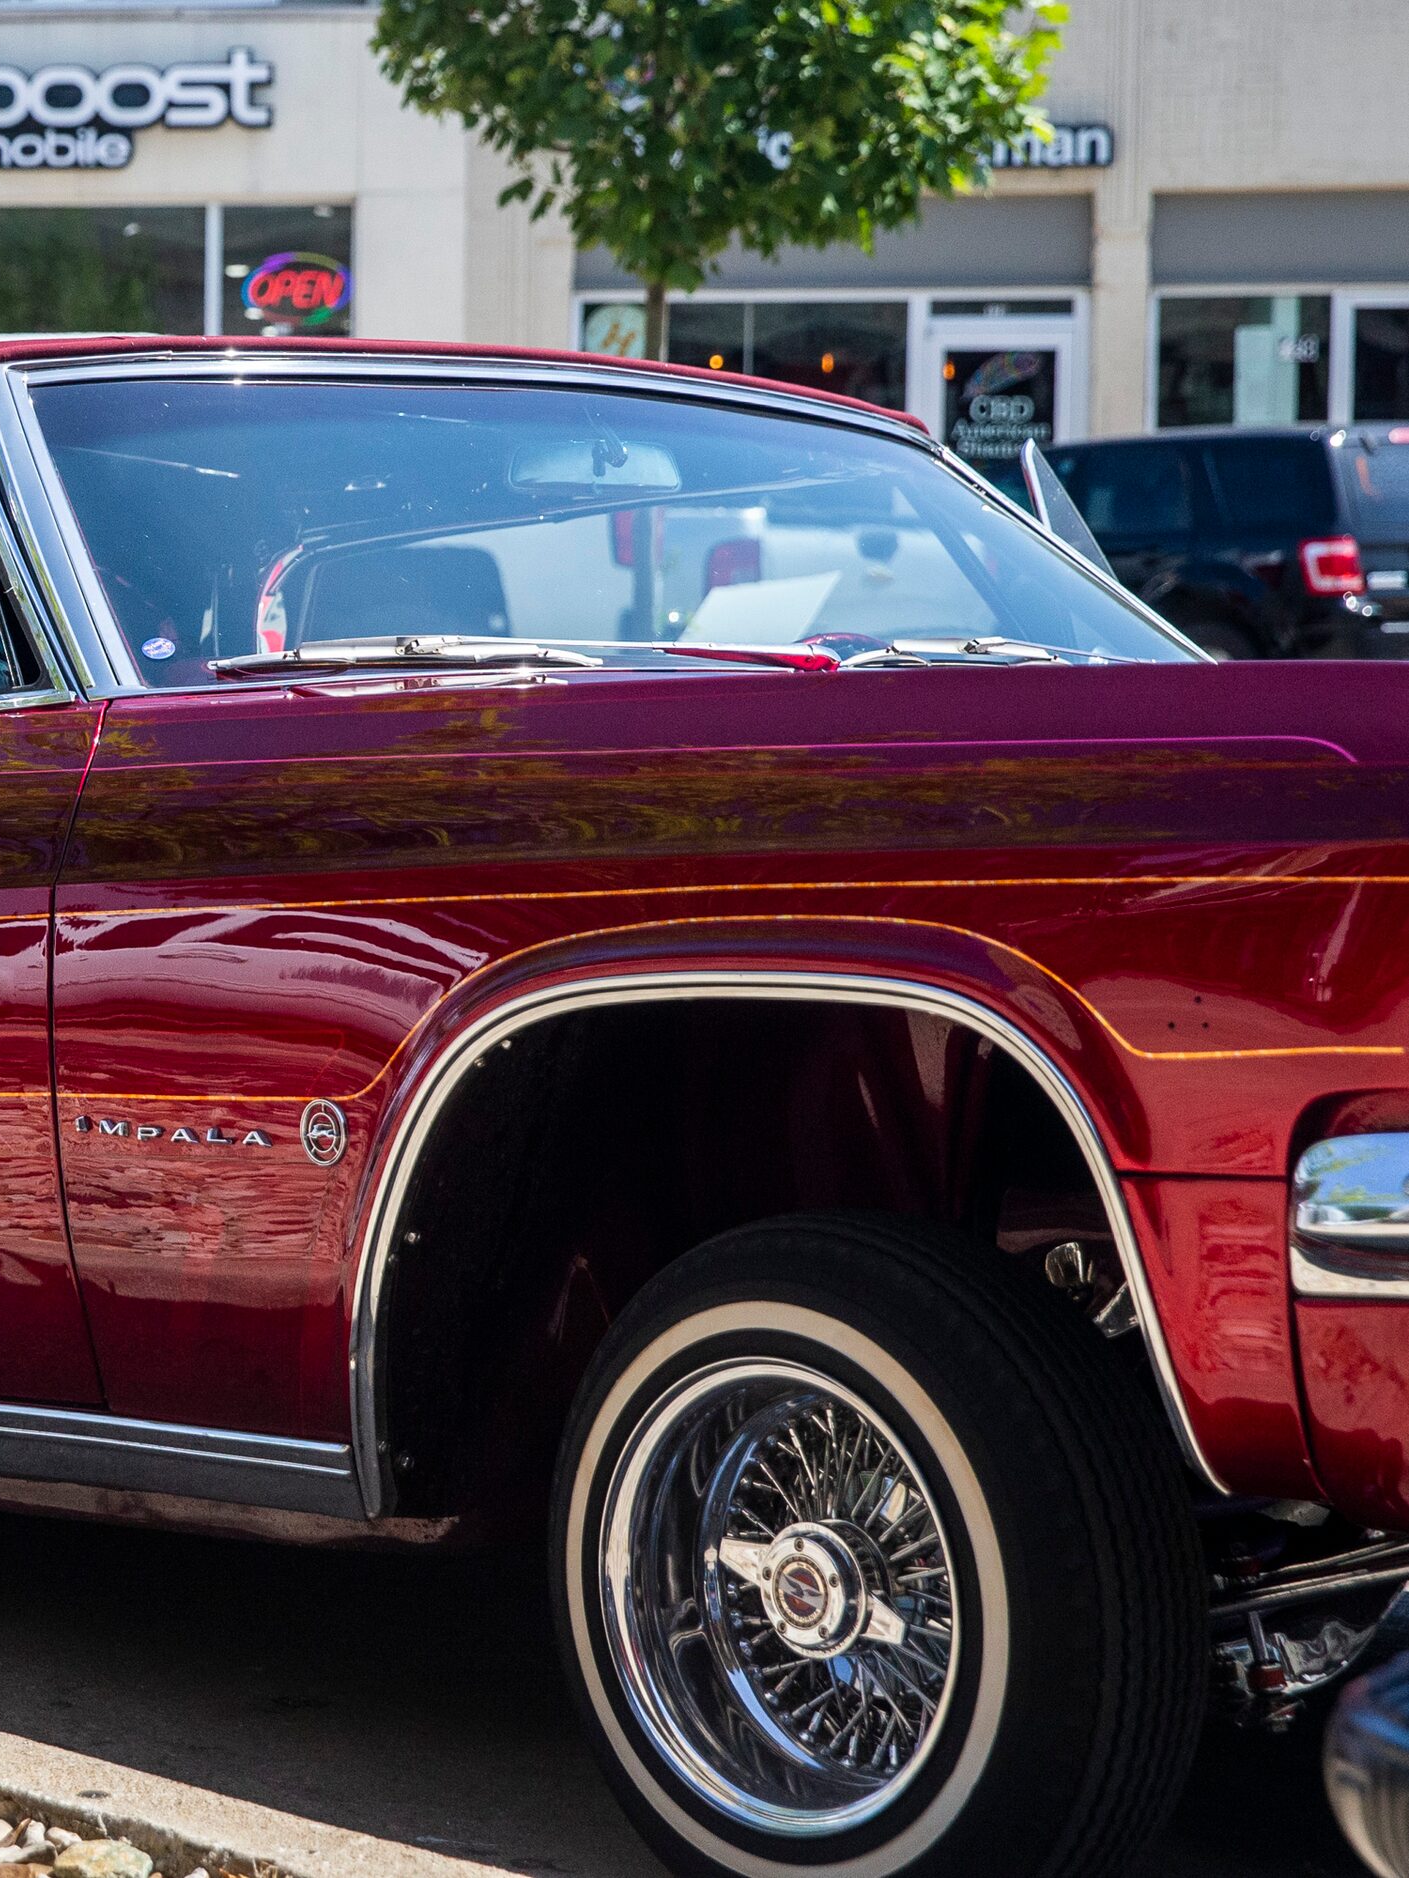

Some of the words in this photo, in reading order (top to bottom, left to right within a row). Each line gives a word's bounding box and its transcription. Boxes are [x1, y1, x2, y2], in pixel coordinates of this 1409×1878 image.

[249, 268, 345, 309] OPEN
[969, 395, 1035, 422] CBD
[75, 1115, 273, 1148] IMPALA
